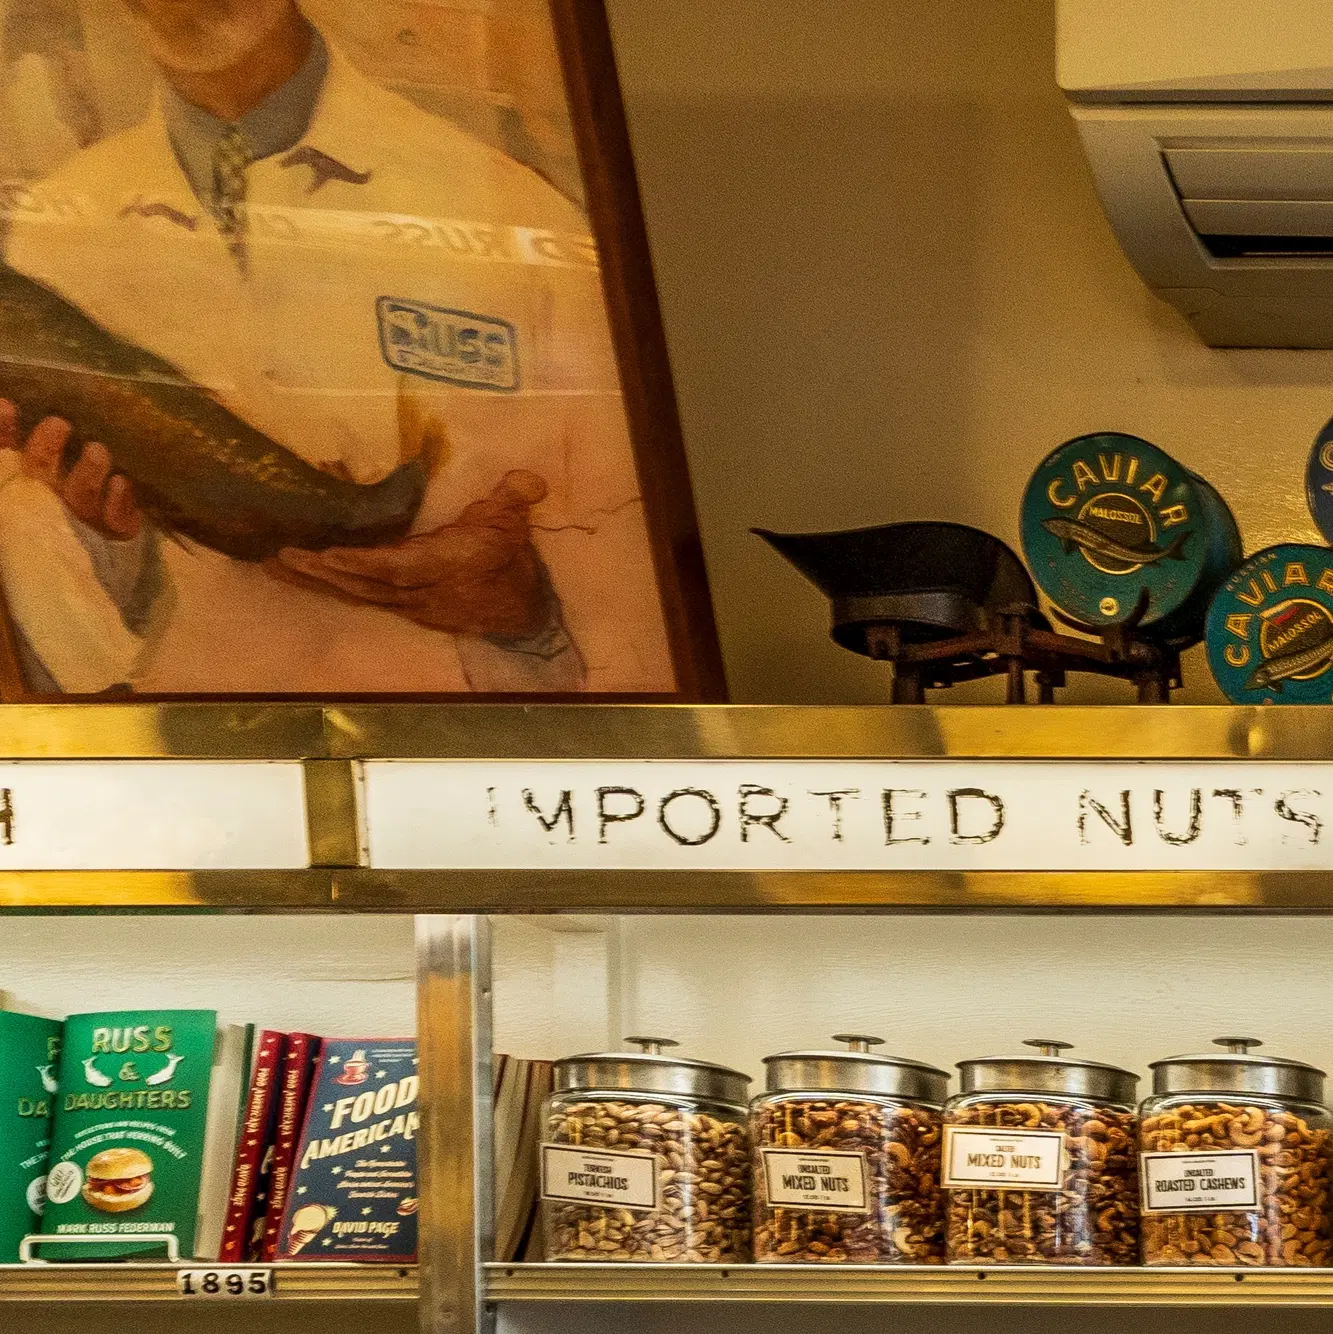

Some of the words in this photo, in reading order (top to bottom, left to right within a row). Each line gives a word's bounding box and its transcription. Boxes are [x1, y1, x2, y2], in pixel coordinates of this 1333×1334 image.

[1047, 452, 1188, 528] CAVIAR
[486, 785, 1004, 848] IMPORTED
[1077, 785, 1325, 848] NUTS
[92, 1025, 173, 1054] RUSS
[118, 1061, 141, 1082] &
[64, 1090, 193, 1112] DAUGHTERS
[329, 1075, 420, 1130] FOOD
[301, 1111, 421, 1170] AMERICAN
[966, 1152, 1005, 1168] MIXED
[1010, 1155, 1043, 1170] NUTS
[567, 1171, 629, 1191] PISTACHIOS
[782, 1174, 816, 1191] MIXED
[820, 1177, 850, 1193] NUTS
[1156, 1178, 1195, 1193] ROASTED
[1199, 1176, 1244, 1191] CASHEWS
[56, 1223, 88, 1234] MARK
[88, 1222, 118, 1233] RUSS
[118, 1221, 175, 1233] FEDERMAN
[331, 1221, 369, 1237] DAVID
[368, 1221, 401, 1238] PAGE
[181, 1272, 267, 1295] 1895
